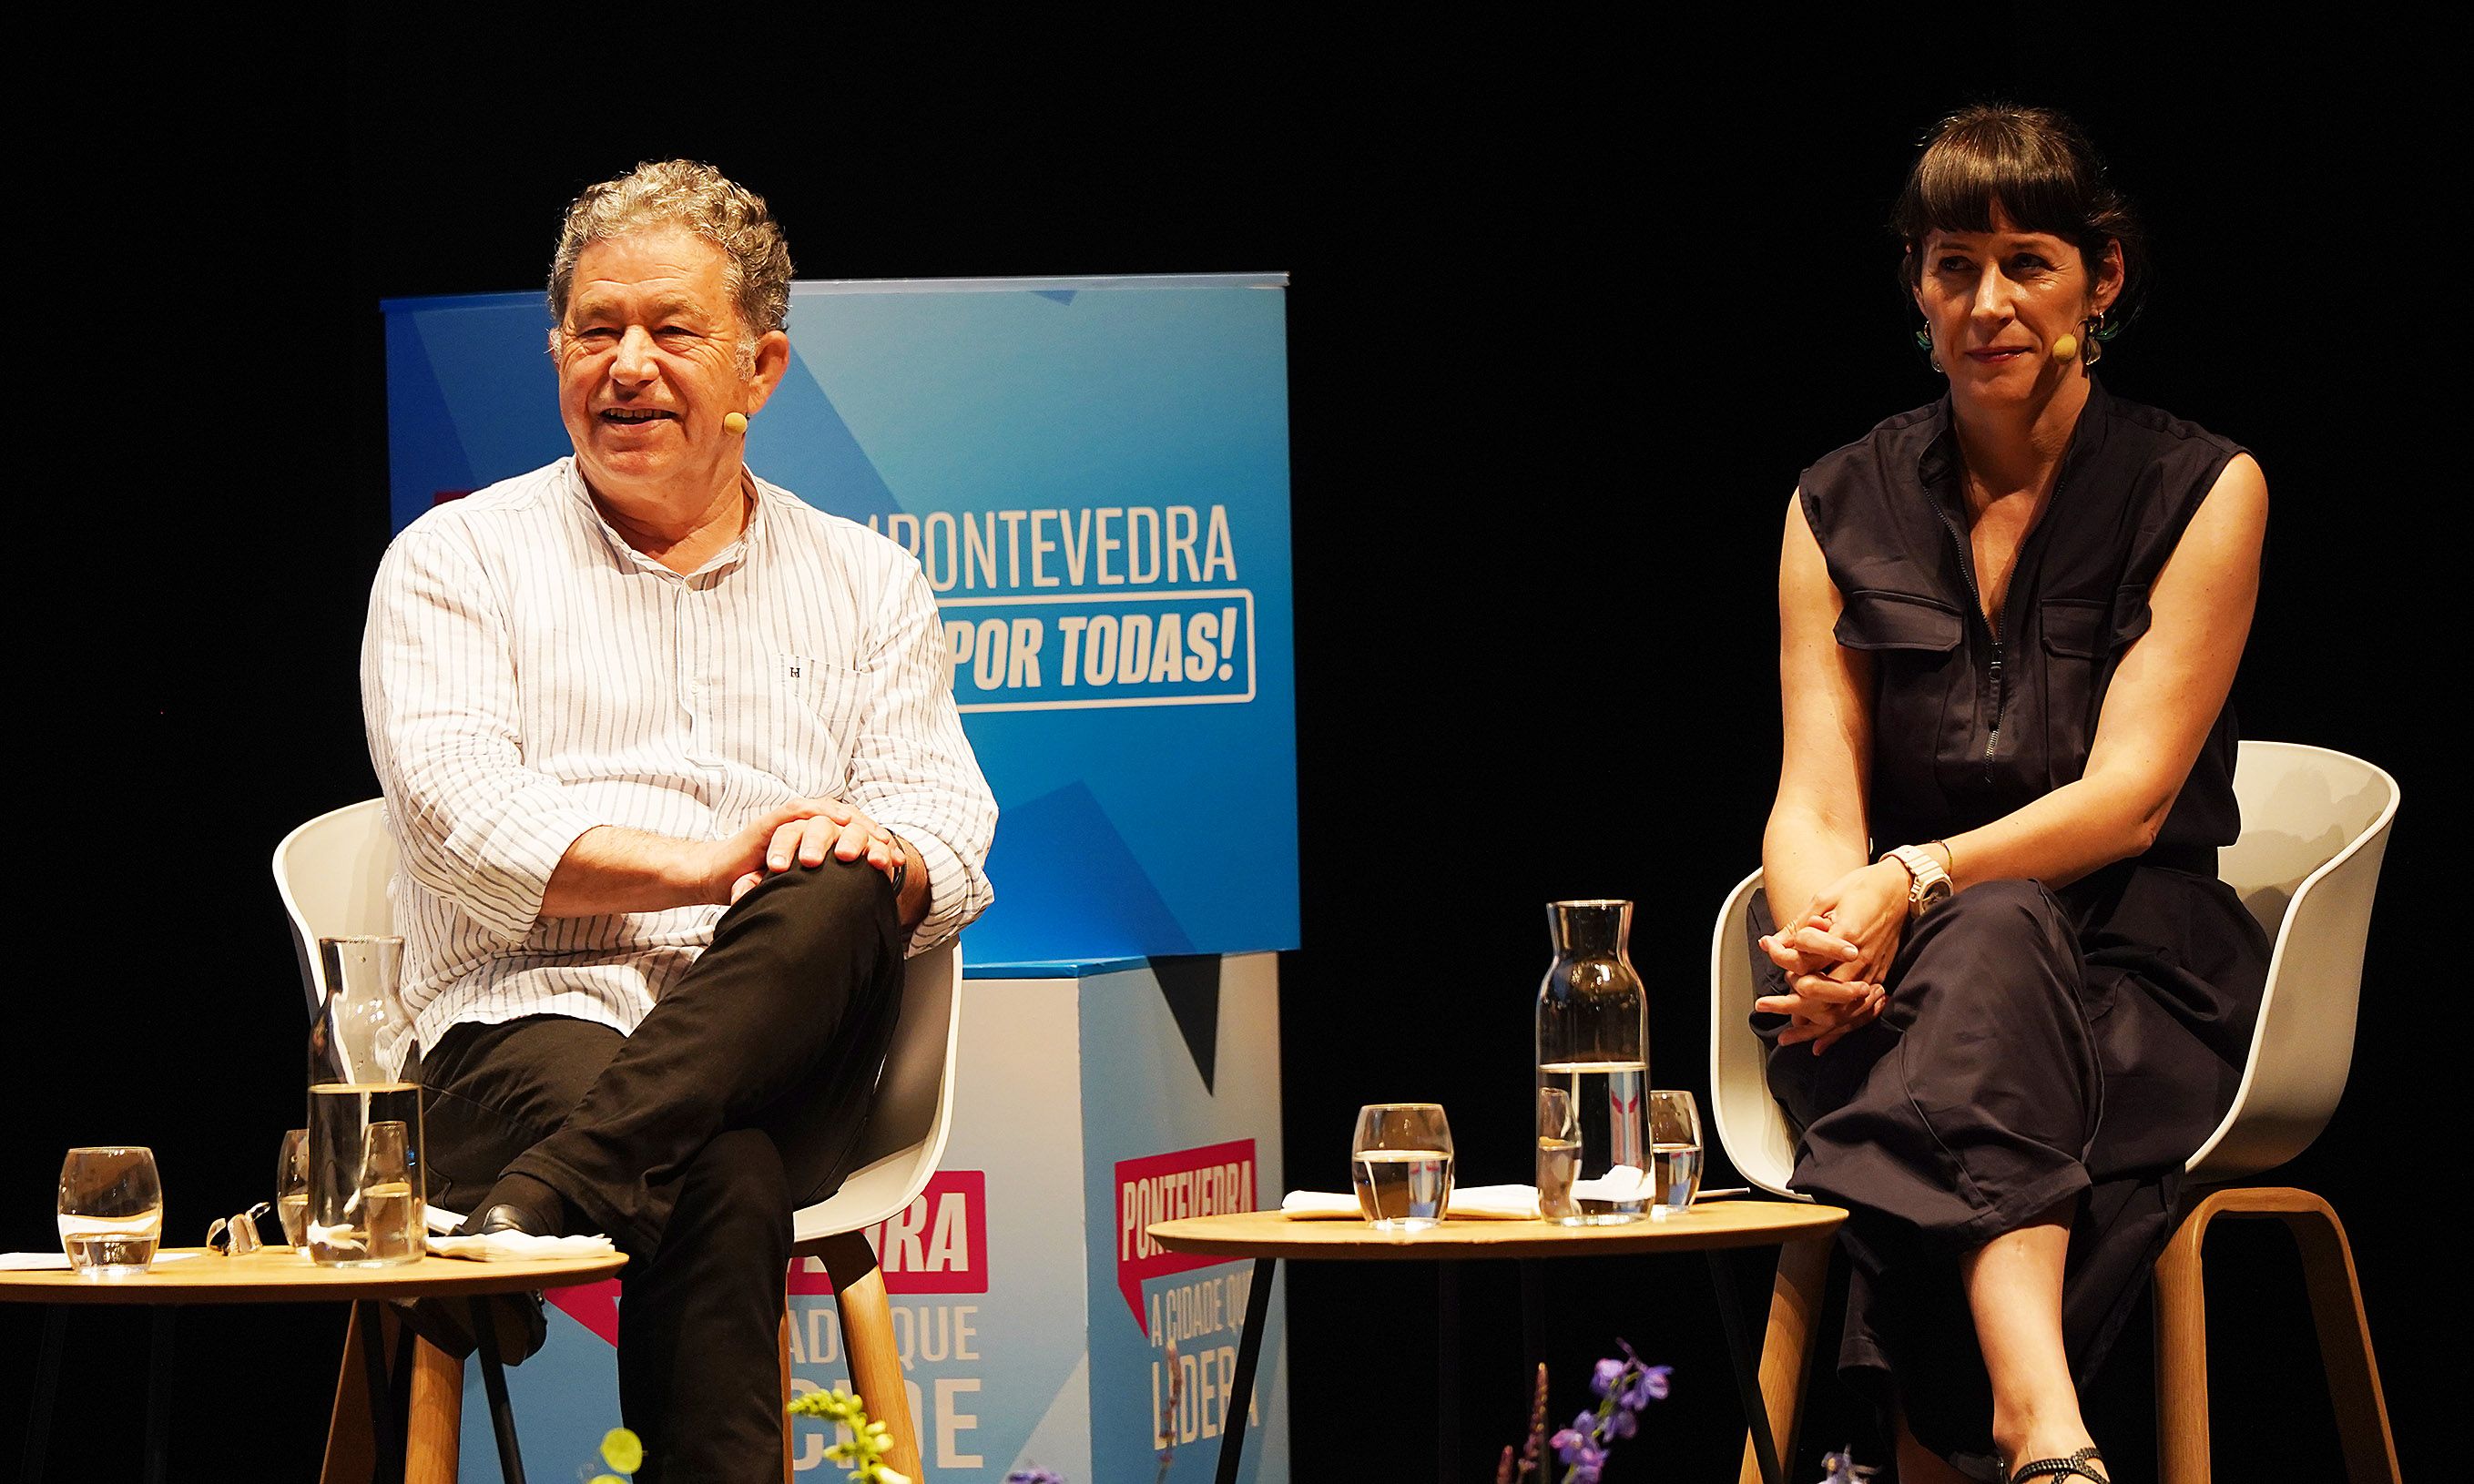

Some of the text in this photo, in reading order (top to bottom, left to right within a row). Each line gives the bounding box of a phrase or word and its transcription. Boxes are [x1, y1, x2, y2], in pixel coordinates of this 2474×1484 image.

[944, 607, 1237, 690] POR TODAS!
[891, 1306, 980, 1370] QUE
[1151, 1294, 1163, 1347] A
[1166, 1278, 1225, 1341] CIDADE
[1151, 1346, 1260, 1450] LIDER
